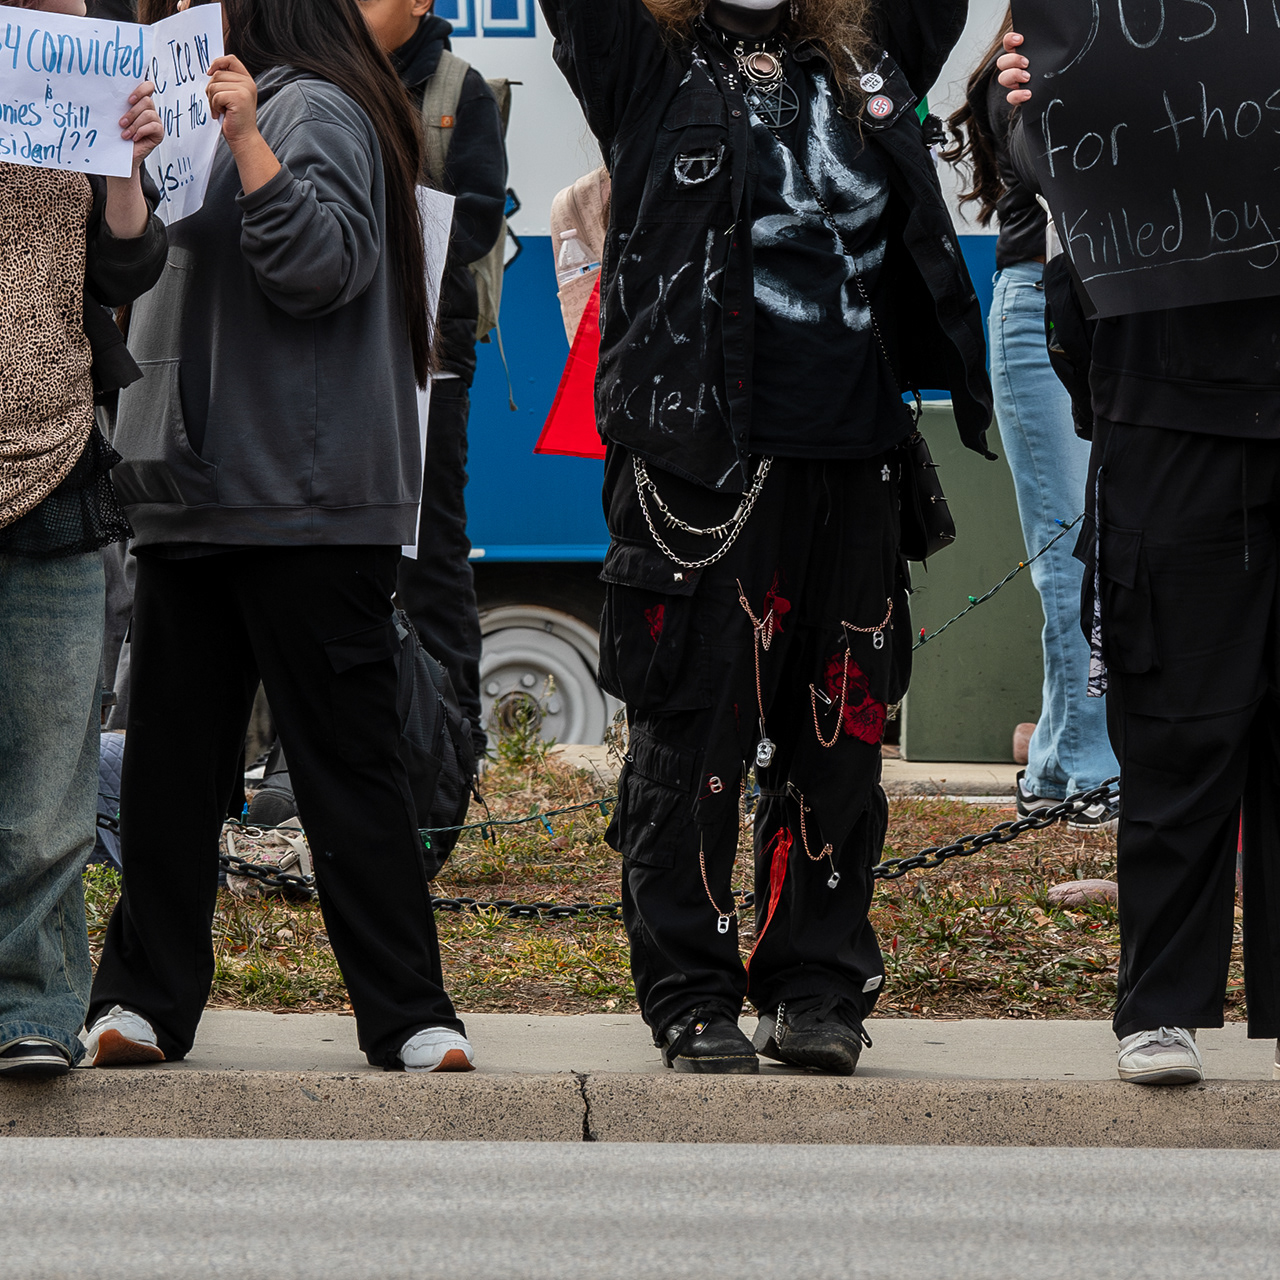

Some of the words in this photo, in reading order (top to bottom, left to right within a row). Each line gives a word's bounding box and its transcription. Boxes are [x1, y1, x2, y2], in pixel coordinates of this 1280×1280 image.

[27, 26, 144, 79] convicted
[168, 38, 195, 87] Ice
[862, 74, 877, 88] MELT
[869, 79, 880, 89] ICE
[53, 102, 90, 128] Still
[1037, 99, 1128, 178] for
[1204, 192, 1280, 269] by
